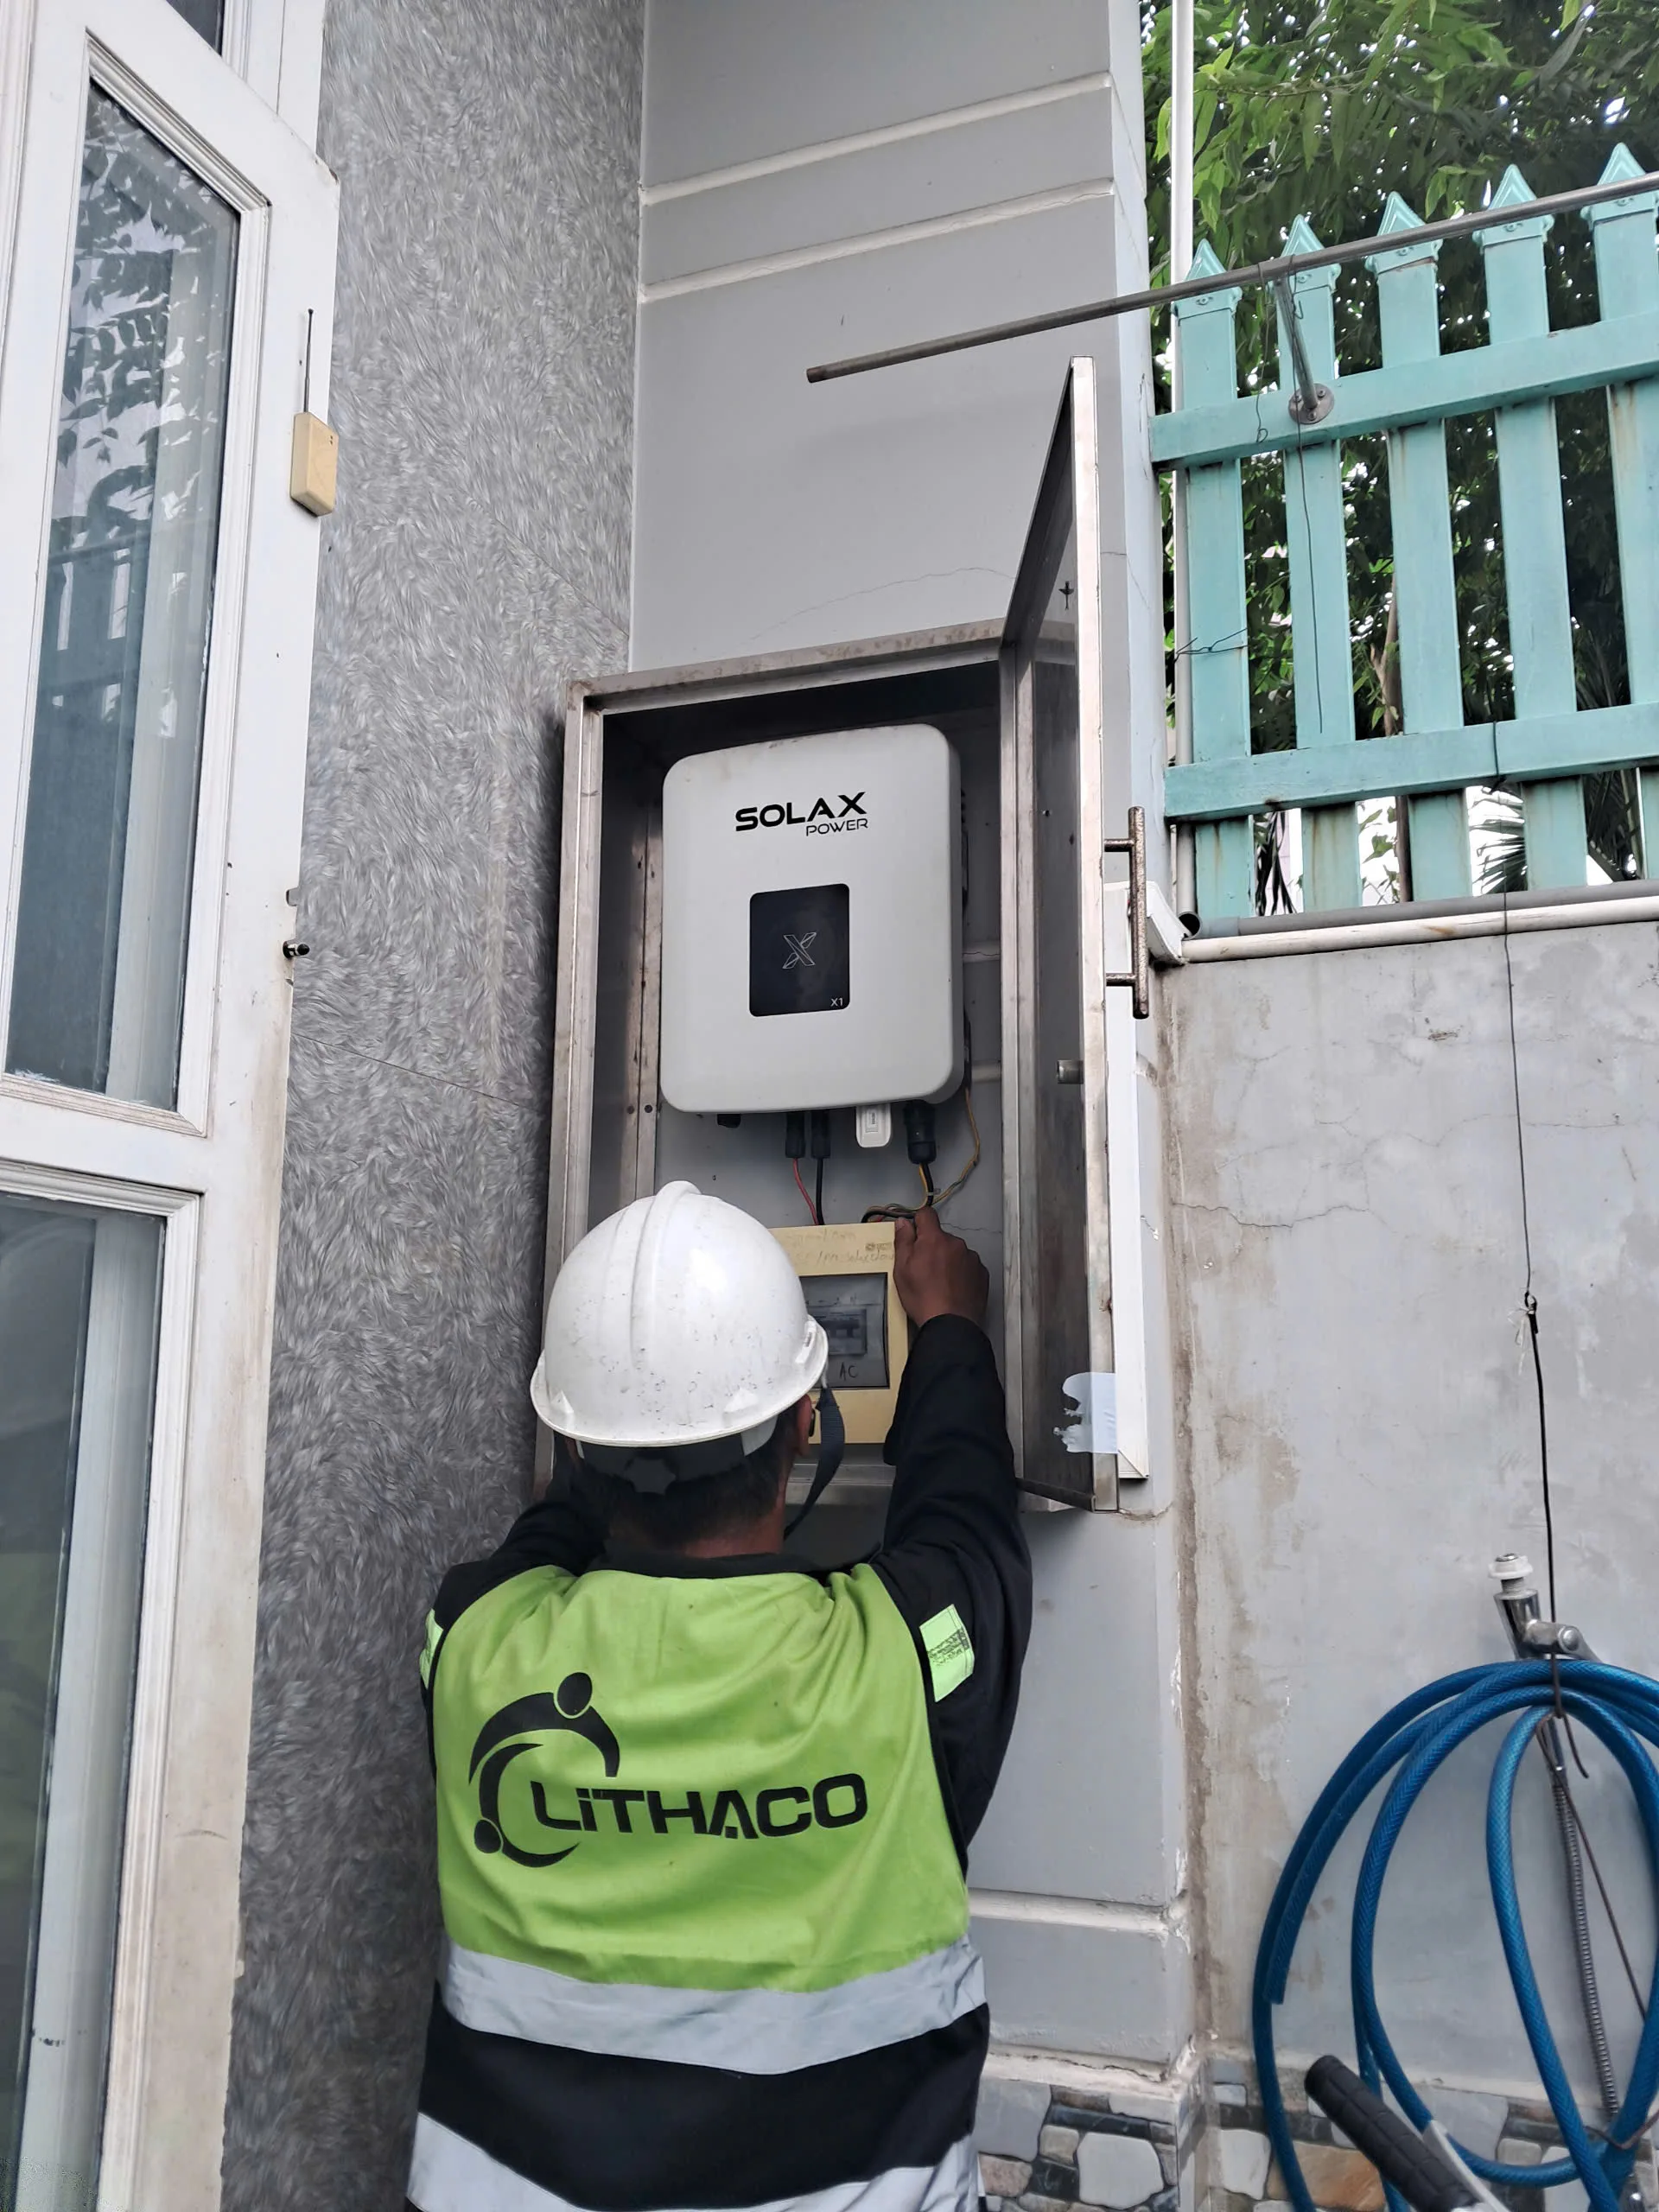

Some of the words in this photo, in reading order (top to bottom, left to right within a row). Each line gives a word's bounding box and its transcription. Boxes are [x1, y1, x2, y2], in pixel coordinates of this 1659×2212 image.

[735, 791, 868, 831] SOLAX
[806, 818, 868, 836] POWER
[830, 997, 843, 1007] X1
[839, 1362, 859, 1381] AC
